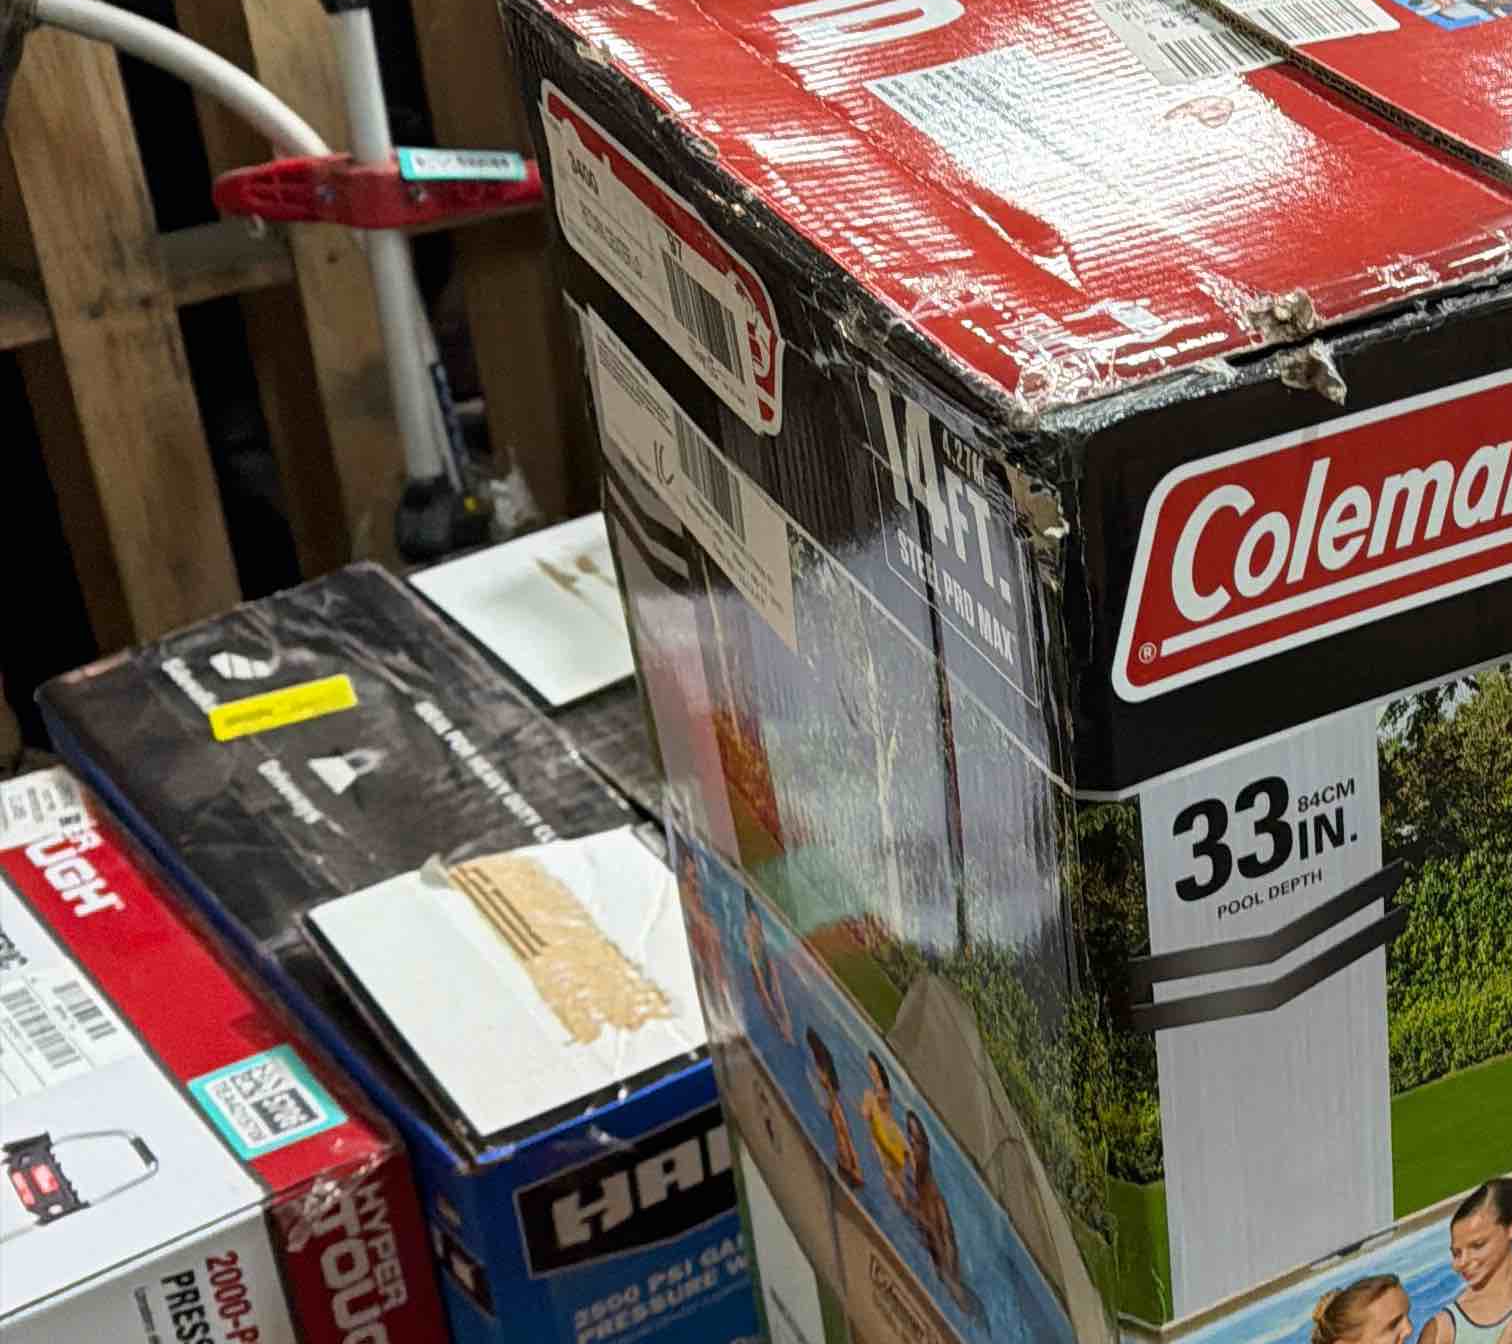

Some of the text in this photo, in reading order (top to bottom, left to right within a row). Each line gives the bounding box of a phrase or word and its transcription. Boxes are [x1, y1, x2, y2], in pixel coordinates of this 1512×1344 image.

[868, 366, 1012, 605] 14 FT.
[897, 527, 1015, 665] STEEL PRO MAX
[1172, 775, 1358, 902] 33 IN.
[1297, 777, 1357, 813] 84CM
[25, 834, 126, 919] UGH
[1216, 867, 1323, 919] POOL DEPTH
[352, 1176, 408, 1312] HYPER
[647, 1257, 693, 1296] PSI
